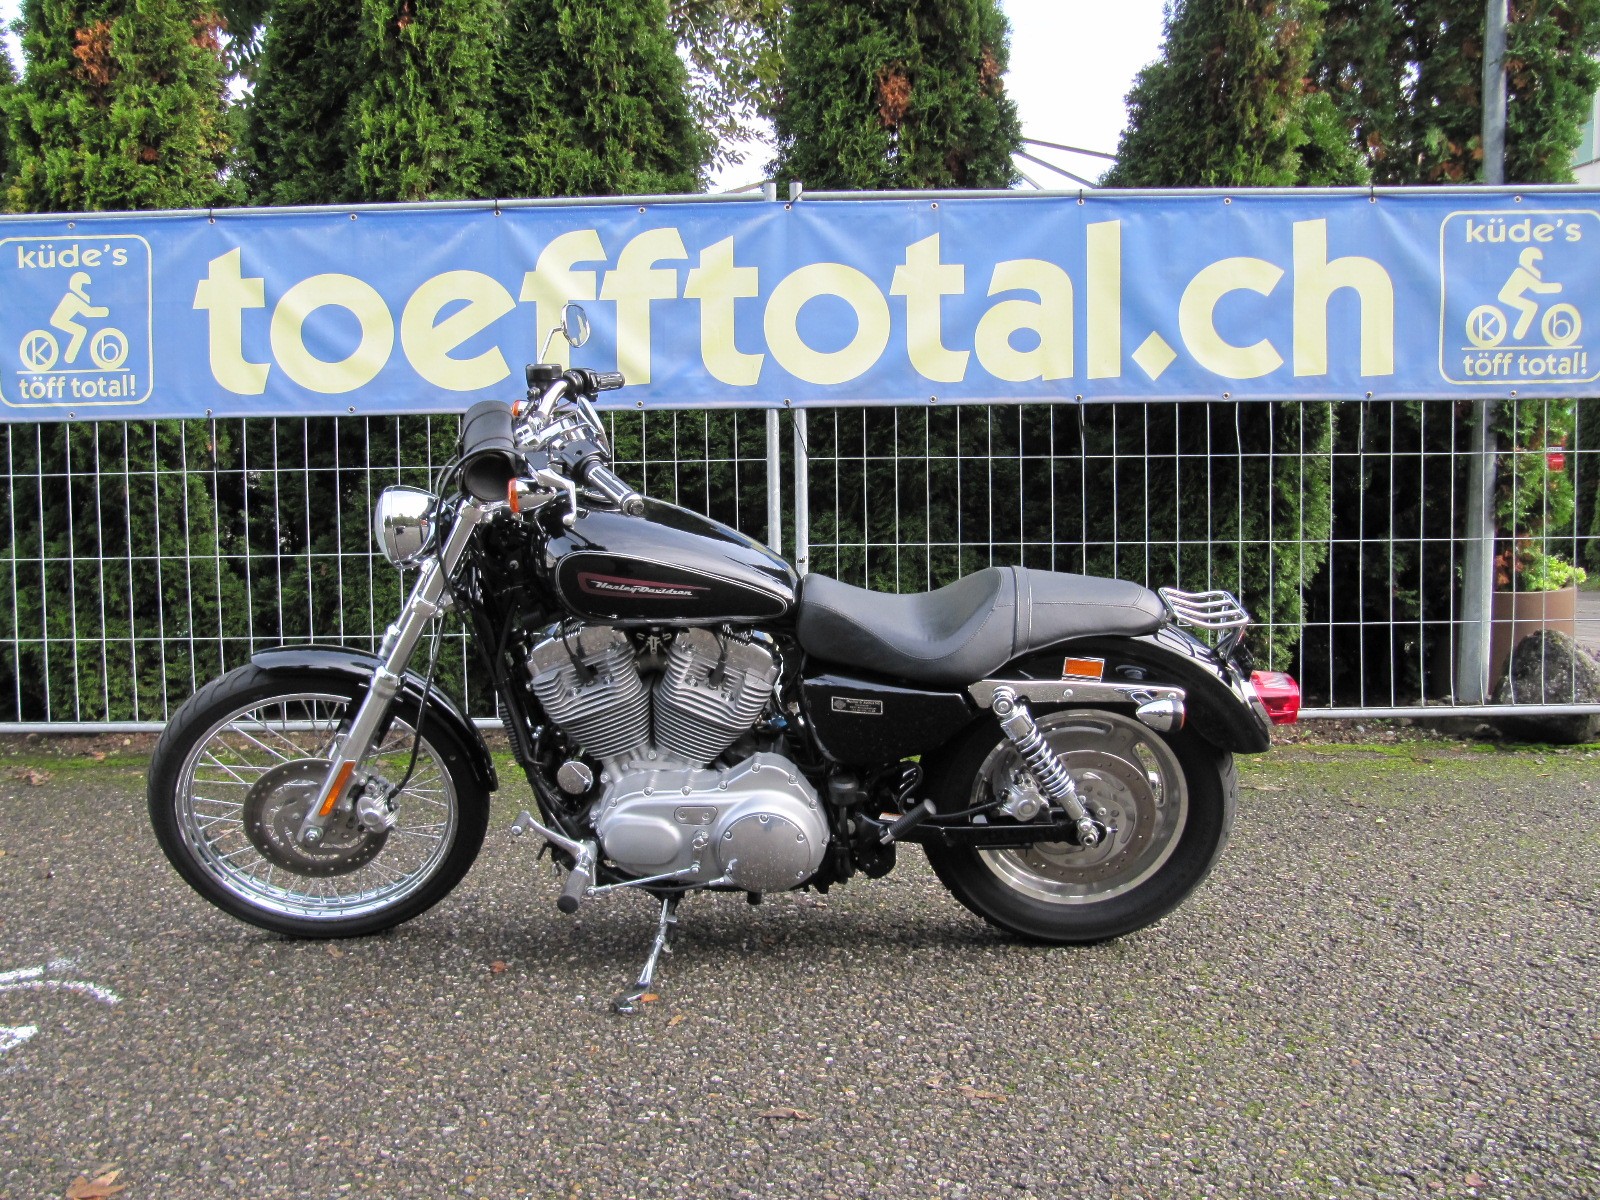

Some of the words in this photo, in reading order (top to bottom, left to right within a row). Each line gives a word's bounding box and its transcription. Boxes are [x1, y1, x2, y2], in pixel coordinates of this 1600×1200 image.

[192, 218, 1395, 396] toefftotal.ch
[1462, 352, 1514, 376] töff
[1518, 351, 1588, 375] total!
[19, 375, 67, 399] töff
[71, 374, 136, 398] total!
